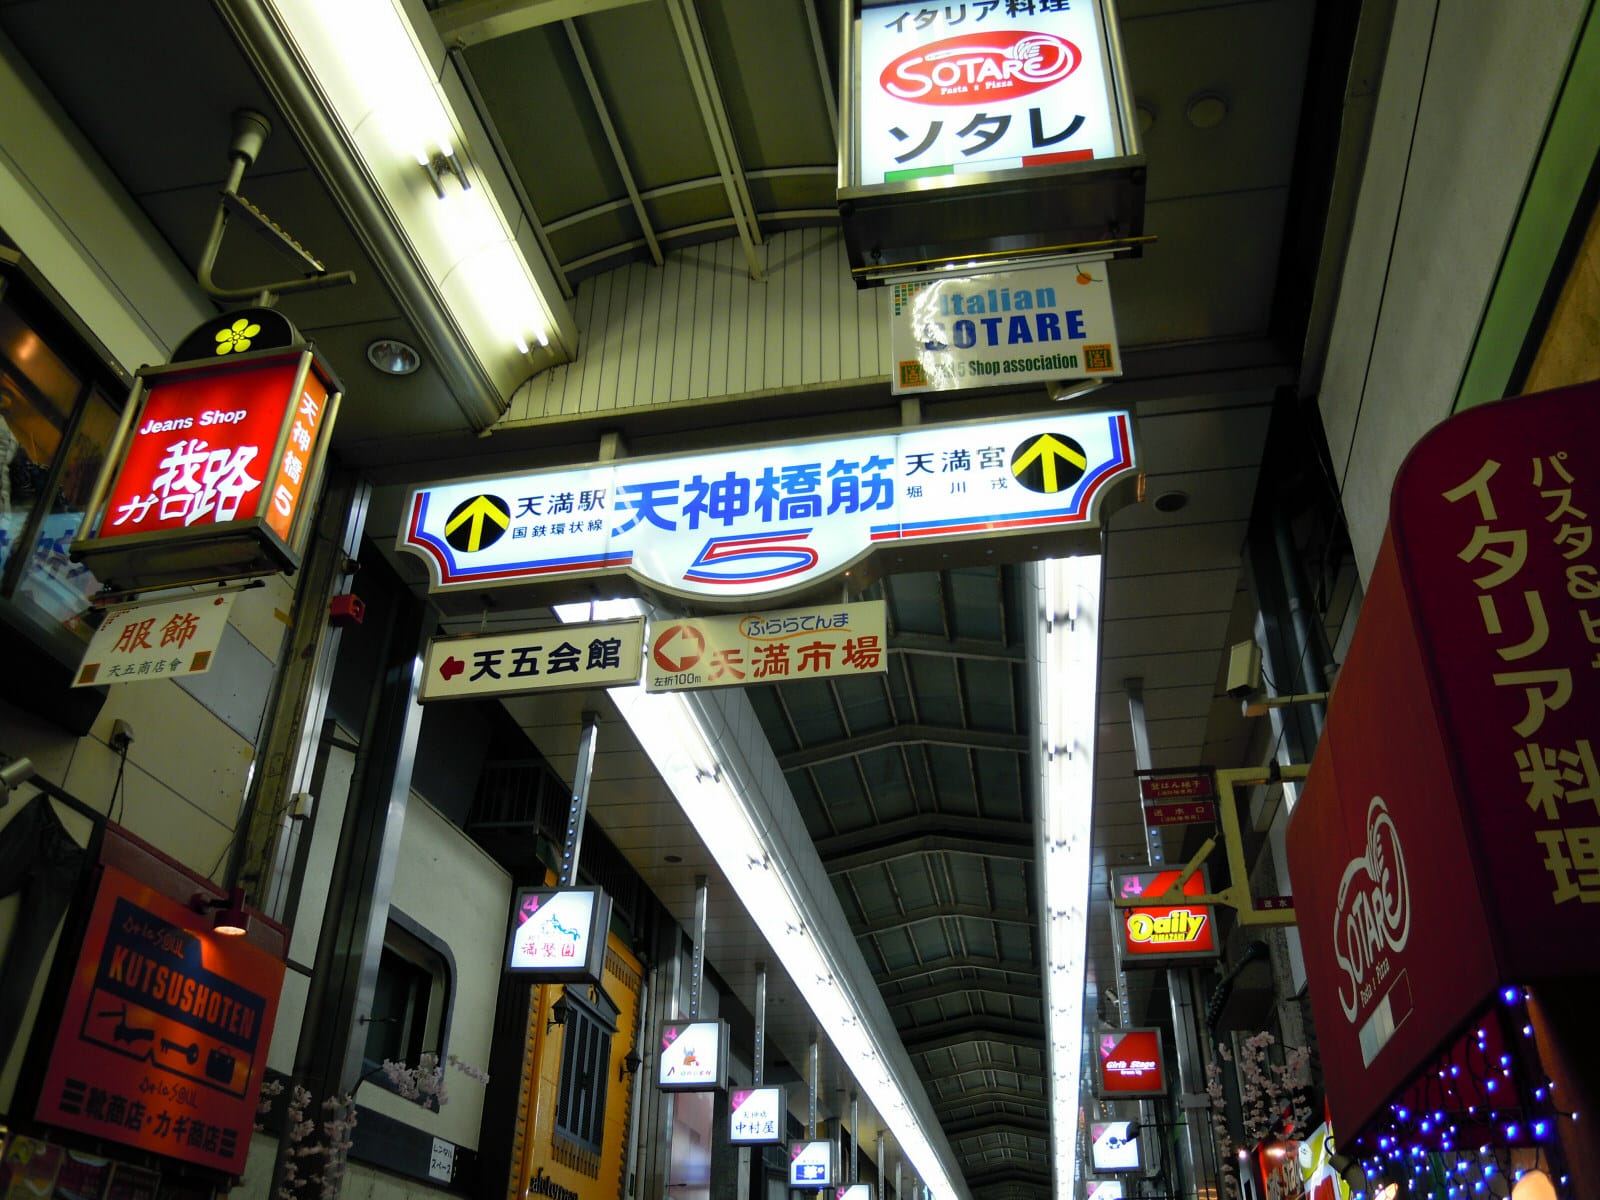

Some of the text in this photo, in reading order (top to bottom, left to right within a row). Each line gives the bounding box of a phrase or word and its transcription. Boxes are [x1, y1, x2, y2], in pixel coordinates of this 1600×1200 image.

[884, 0, 1070, 33] イタリア料理
[886, 54, 1046, 98] SOTARE
[889, 108, 1086, 164] ソタレ
[939, 287, 1057, 317] Italian
[968, 359, 1001, 378] Shop
[1003, 354, 1079, 374] association
[140, 408, 248, 435] Jeans Shop
[904, 446, 1006, 477] 天満宮
[515, 488, 607, 519] 天満駅
[611, 454, 895, 538] 天神橋筋
[511, 519, 604, 540] 国鉄環状線
[111, 612, 201, 654] 服飾
[107, 657, 183, 678] 天五商店會
[469, 637, 622, 682] 天五会館
[707, 635, 882, 681] 天満市場
[654, 673, 702, 688] 左折100m
[1441, 459, 1600, 905] イタリア料理
[1128, 911, 1206, 942] Daily
[109, 943, 257, 1040] KUTSUSHOTEN
[735, 1120, 775, 1136] 中村屋
